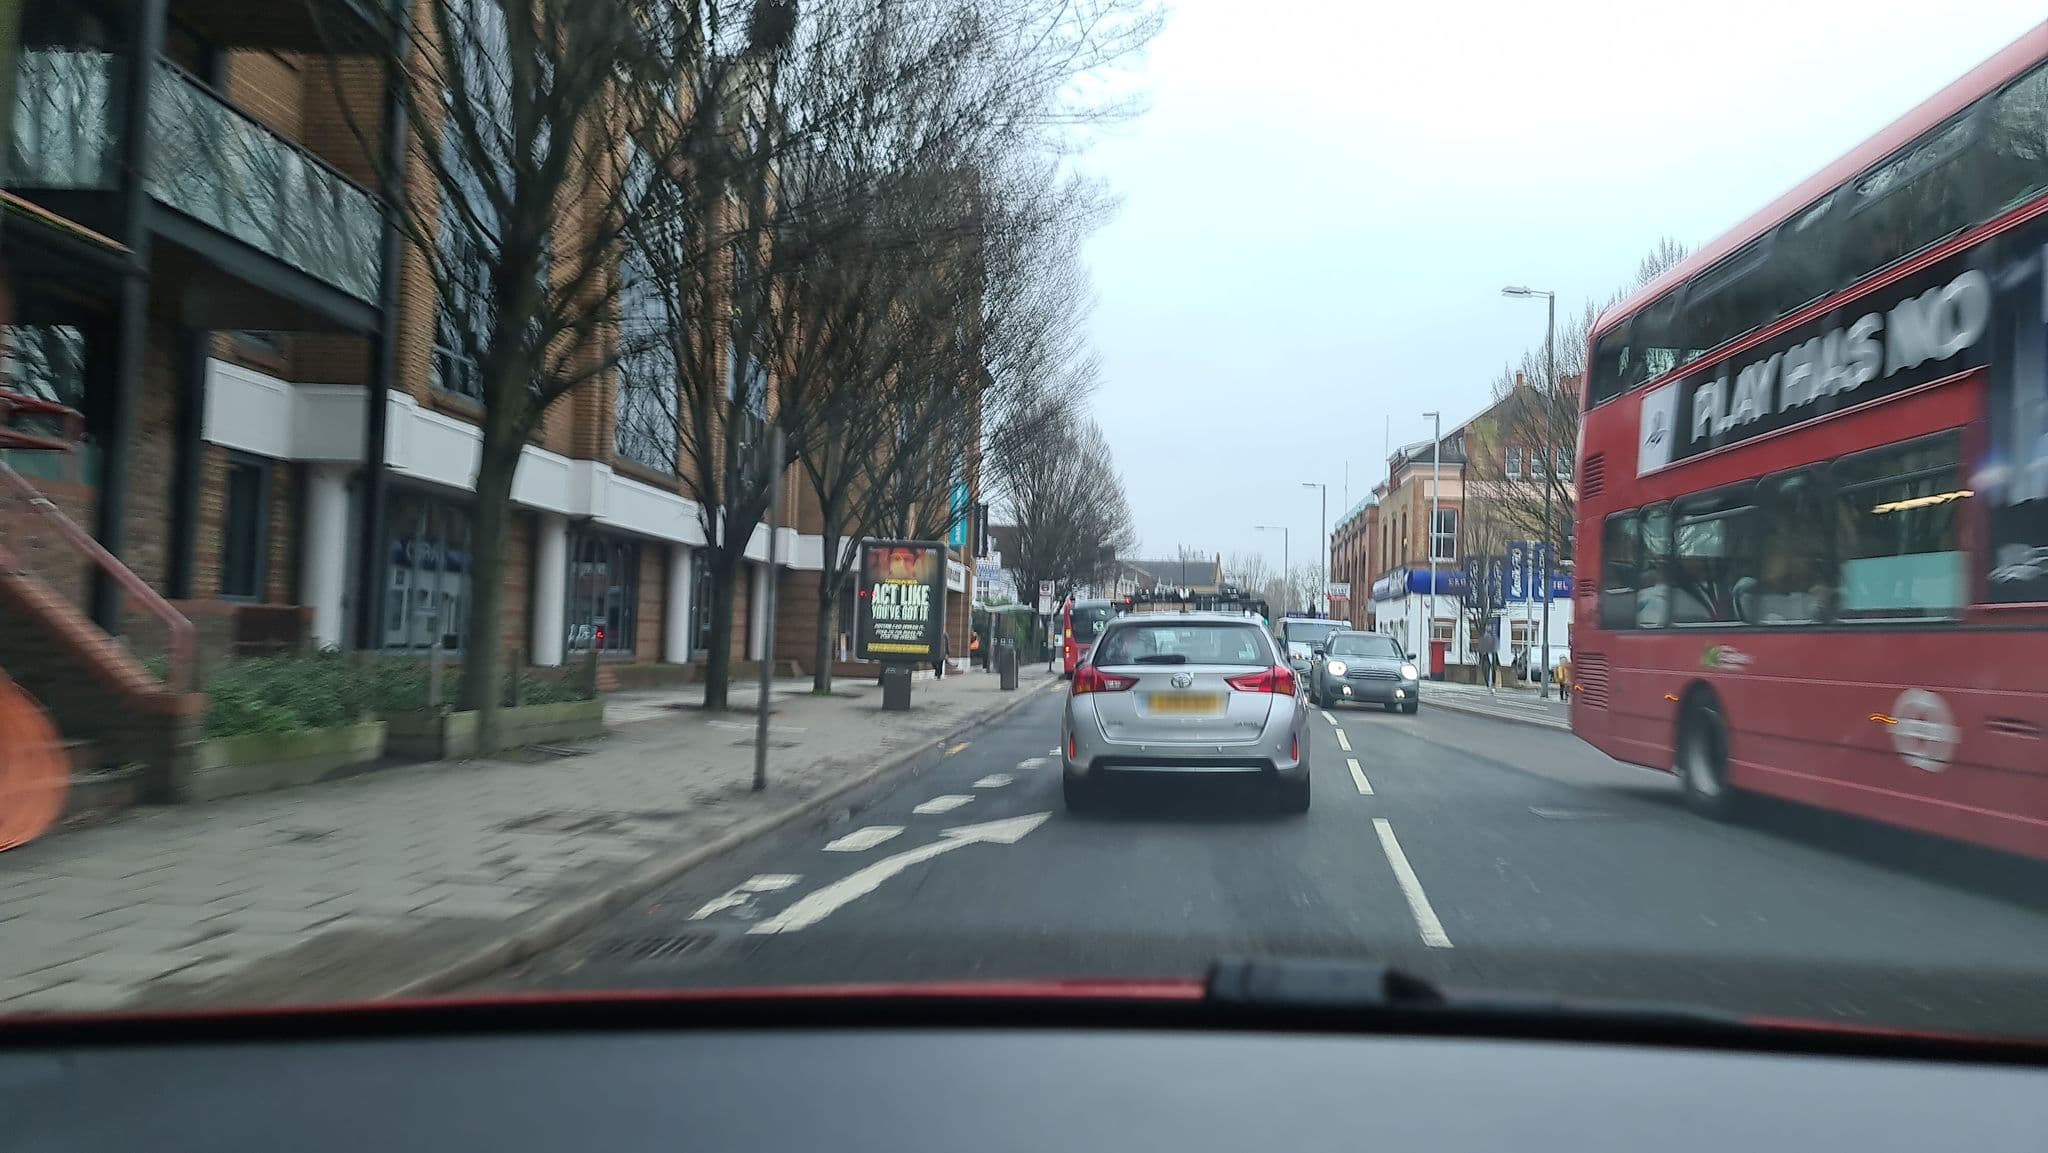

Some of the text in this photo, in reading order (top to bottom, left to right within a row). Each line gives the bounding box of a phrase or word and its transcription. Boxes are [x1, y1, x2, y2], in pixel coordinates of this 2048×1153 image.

[1690, 269, 1990, 444] PLAY HAS NO
[871, 583, 930, 606] ACT LIKE
[901, 605, 919, 621] GOT
[919, 605, 930, 622] IT
